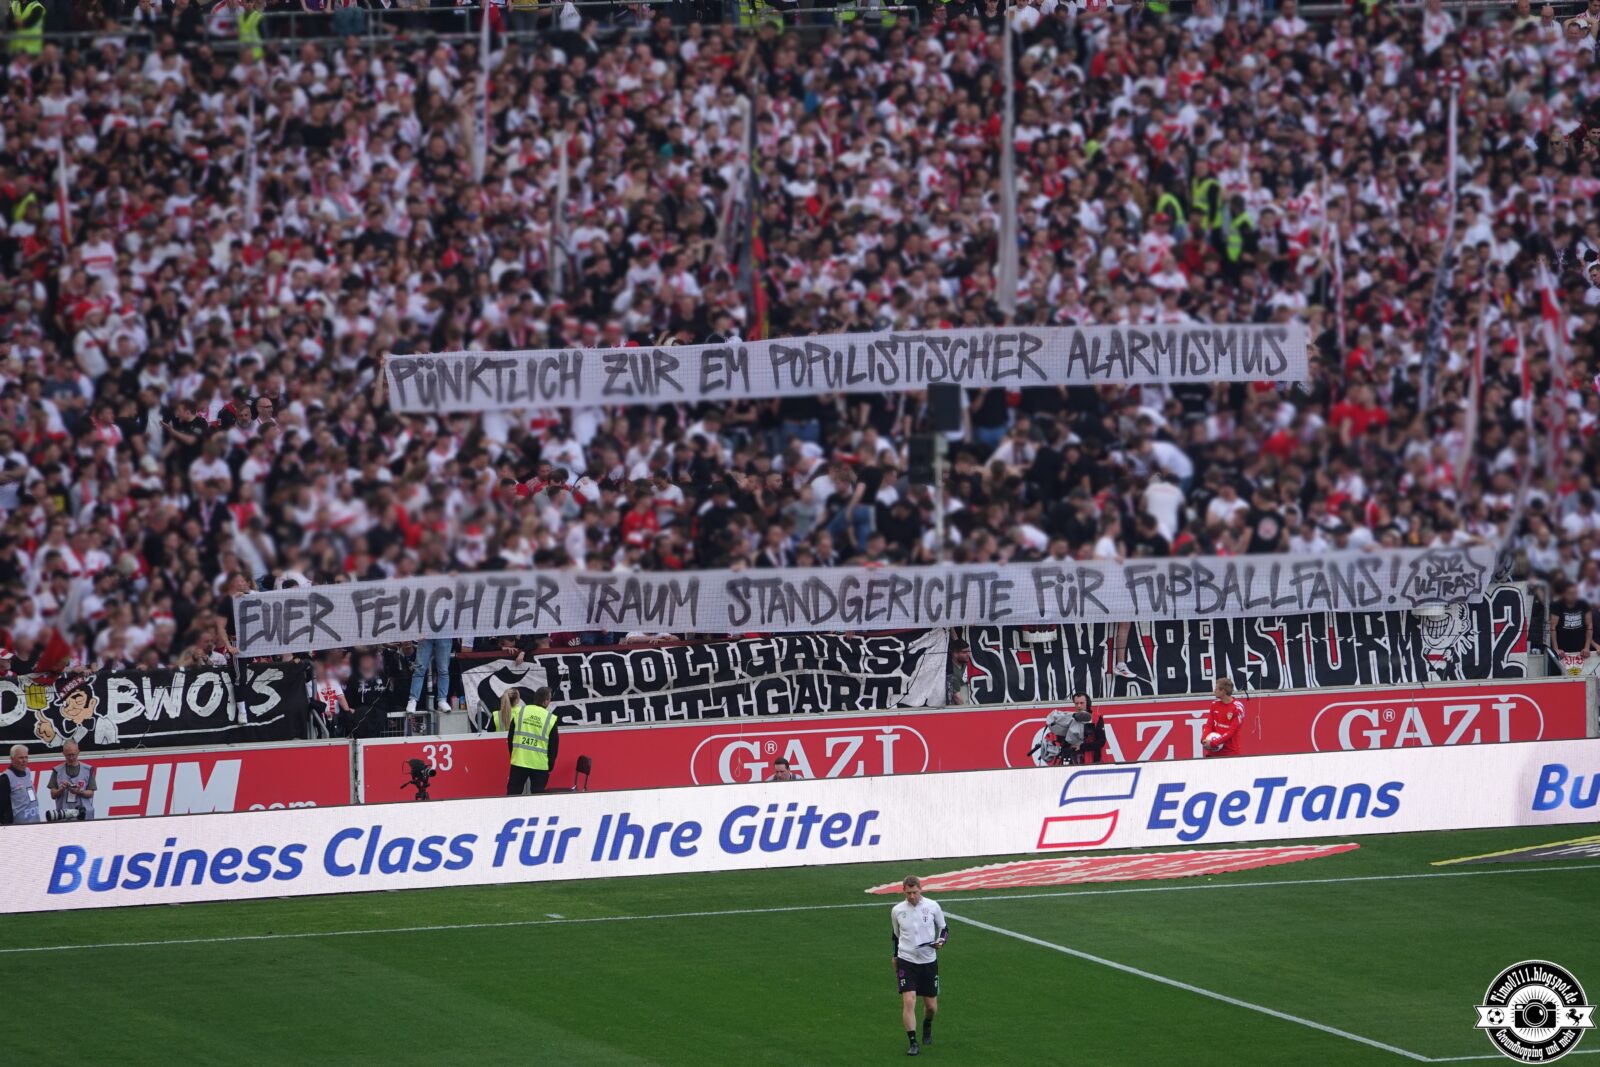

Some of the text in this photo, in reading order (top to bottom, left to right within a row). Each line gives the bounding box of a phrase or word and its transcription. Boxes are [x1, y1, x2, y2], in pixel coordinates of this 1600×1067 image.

[389, 328, 1288, 406] PÜNKTLICH ZUR EM POPULISTISCHER ALARMISMUS
[238, 591, 341, 652] EUER
[351, 575, 562, 638] FEUCHTER
[576, 575, 698, 627] TRAUM
[726, 572, 1015, 627] STANDGERICHTE
[1031, 566, 1110, 618] FÜR
[536, 634, 906, 702] HOOLIGANS
[423, 743, 453, 771] 33
[1146, 776, 1405, 842] EgeTrans
[47, 802, 881, 895] Business Class für Ihre Güter.
